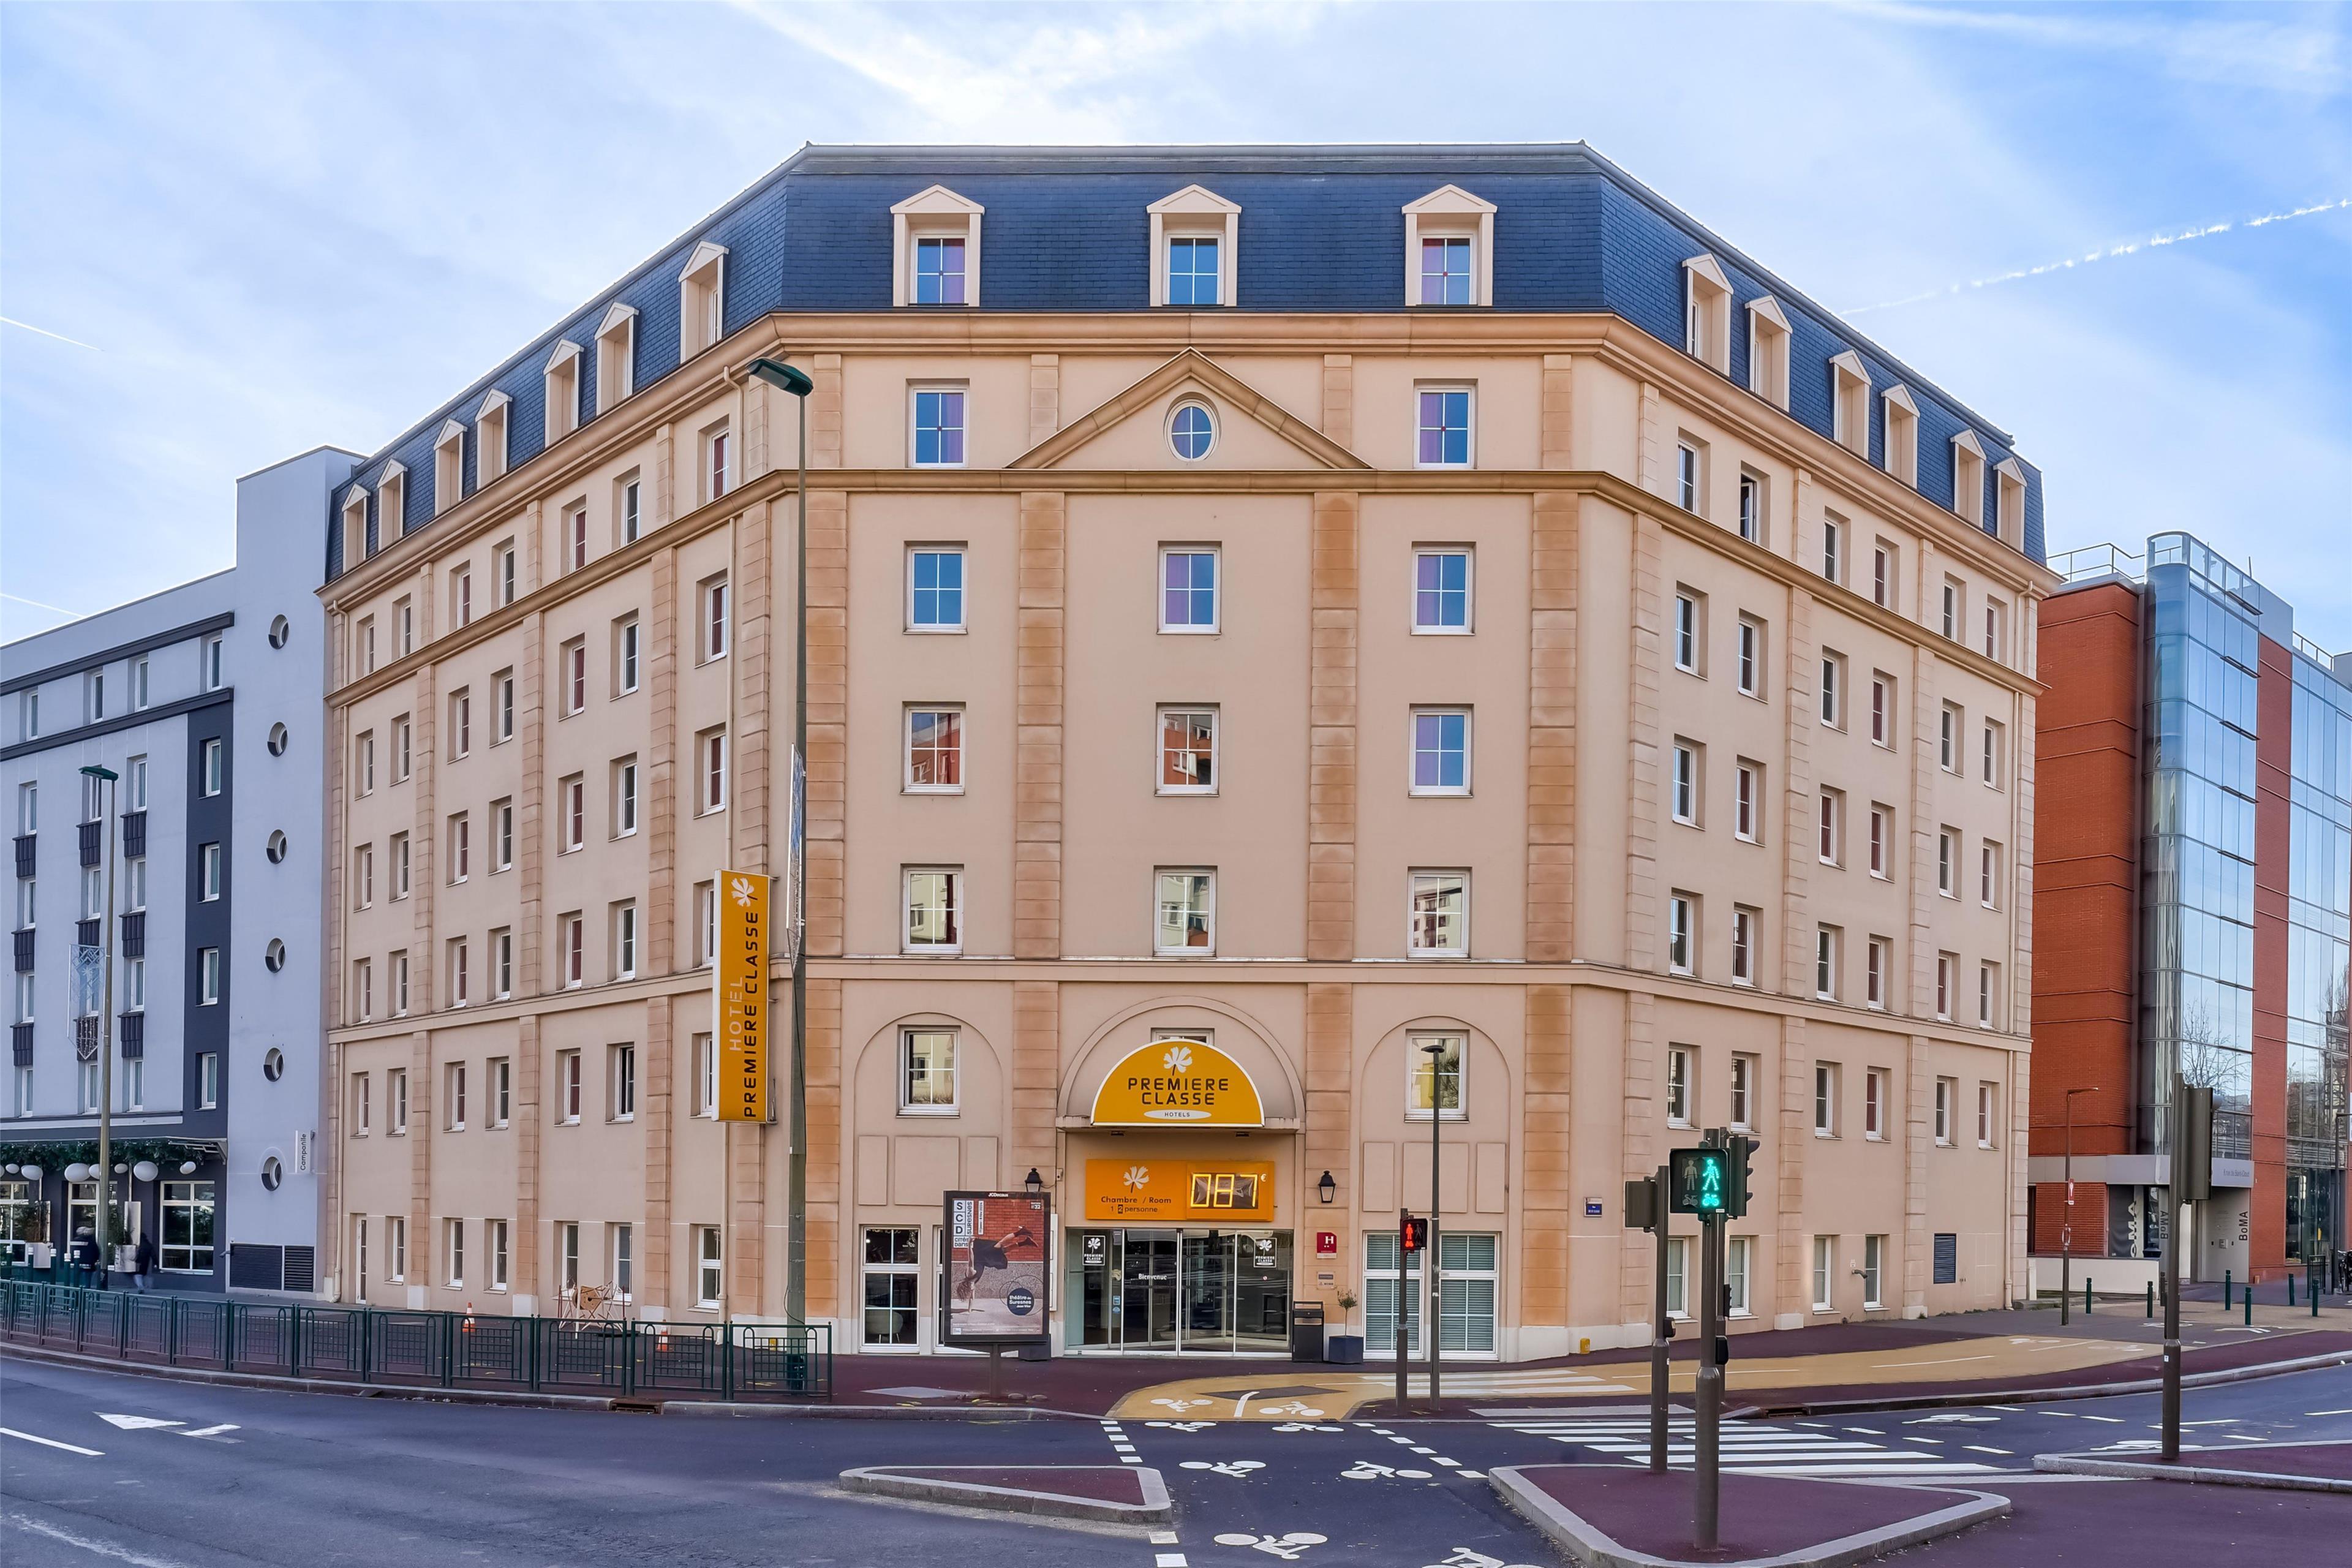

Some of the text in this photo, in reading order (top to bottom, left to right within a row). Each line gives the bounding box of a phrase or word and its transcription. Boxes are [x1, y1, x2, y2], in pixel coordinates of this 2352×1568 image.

[729, 977, 742, 1052] HOTEL
[744, 911, 759, 1117] PREMIERE CLASSE
[1128, 1077, 1229, 1091] PREMIERE
[1142, 1092, 1214, 1105] CLASSE
[1261, 1174, 1267, 1182] €
[956, 1202, 963, 1210] S
[956, 1226, 963, 1234] D
[2239, 1211, 2248, 1241] BoMA
